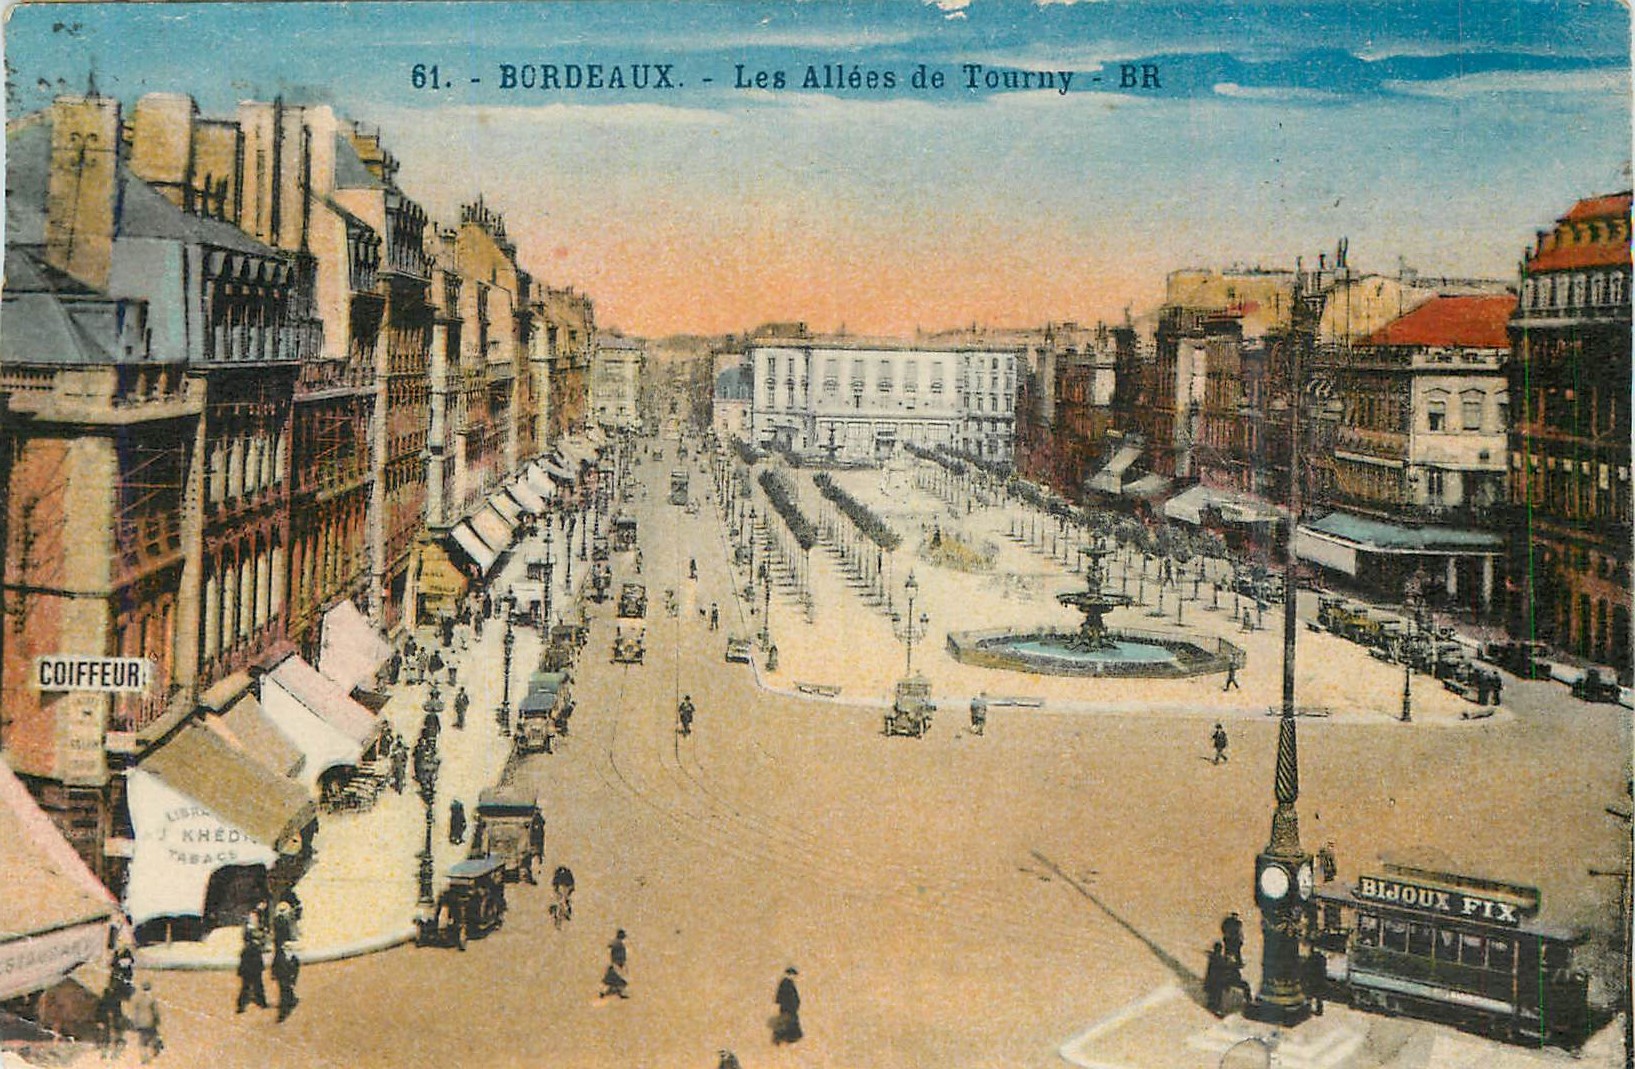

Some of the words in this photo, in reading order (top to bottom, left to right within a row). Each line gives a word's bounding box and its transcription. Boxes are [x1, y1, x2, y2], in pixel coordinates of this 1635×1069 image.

[40, 660, 140, 688] COIFFEUR
[1361, 877, 1450, 912] BIJOUX
[1461, 896, 1518, 923] FIX
